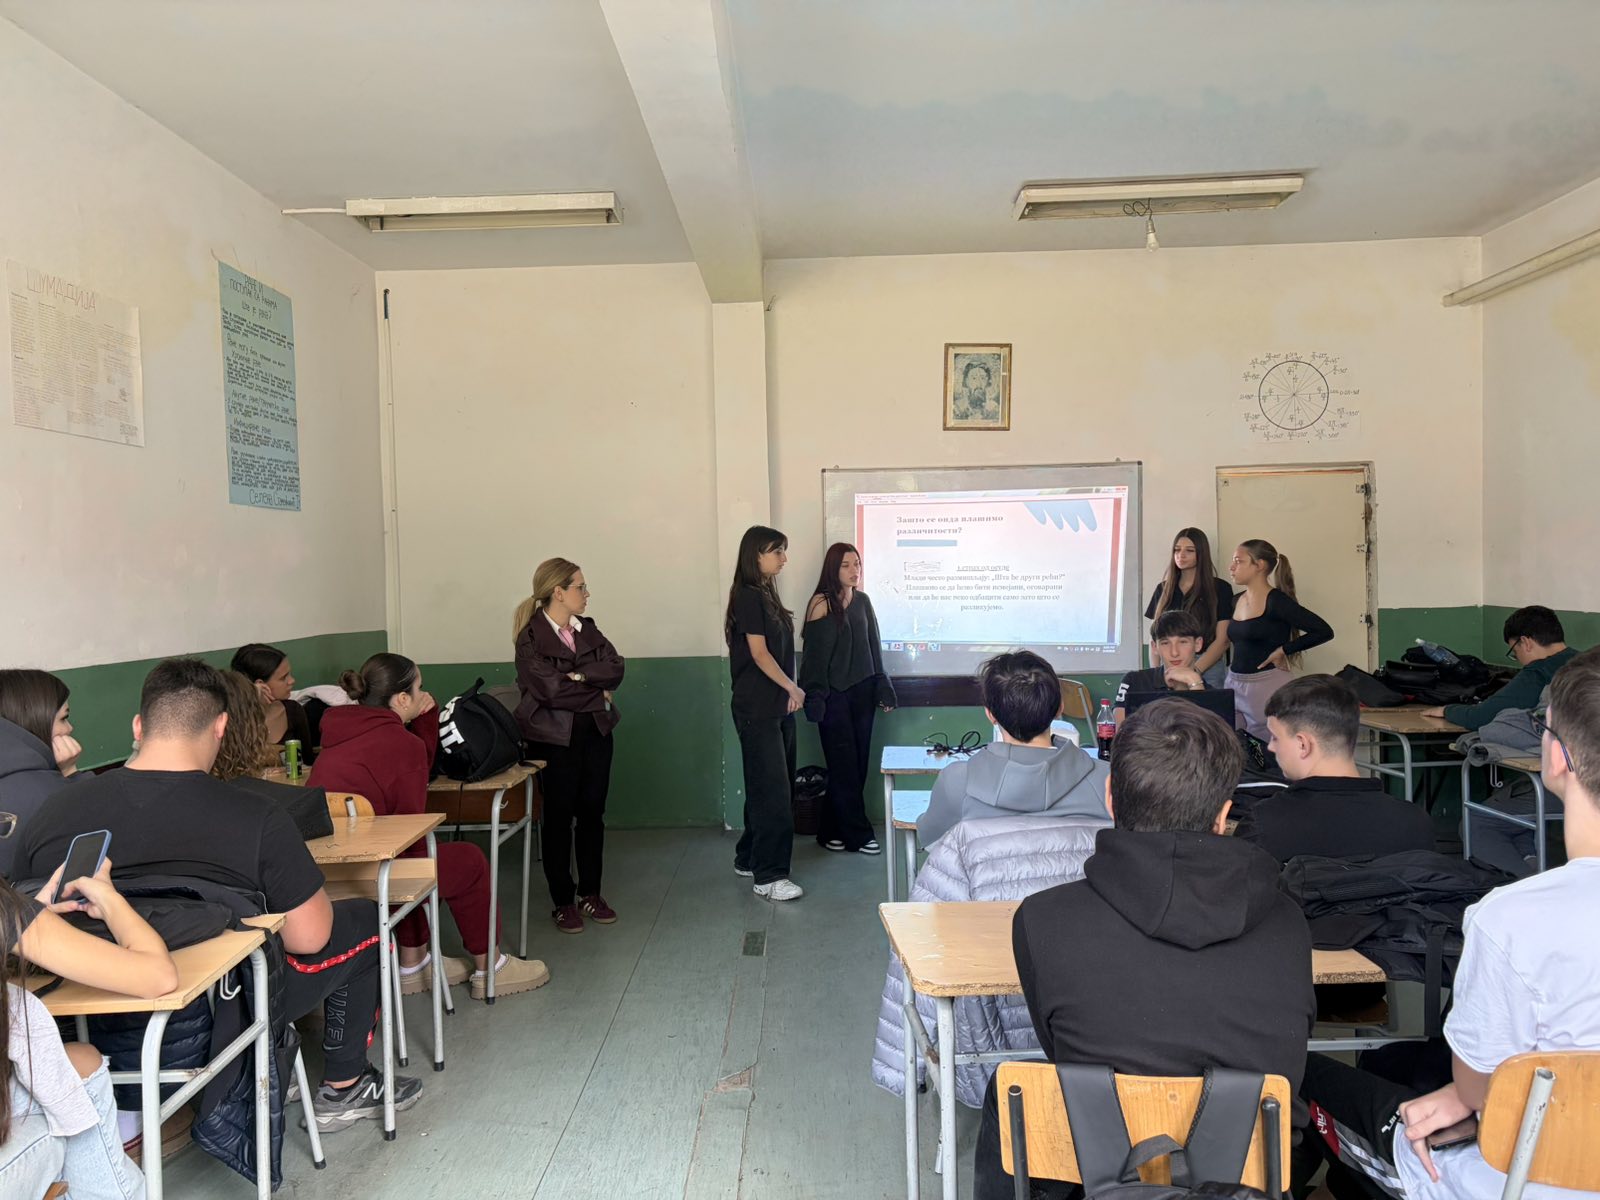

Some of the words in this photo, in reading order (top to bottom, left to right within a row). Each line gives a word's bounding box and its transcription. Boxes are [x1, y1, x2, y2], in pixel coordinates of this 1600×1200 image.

[26, 268, 97, 313] ШУМАДИЈА
[896, 527, 962, 536] различитости?
[1116, 683, 1130, 702] 5
